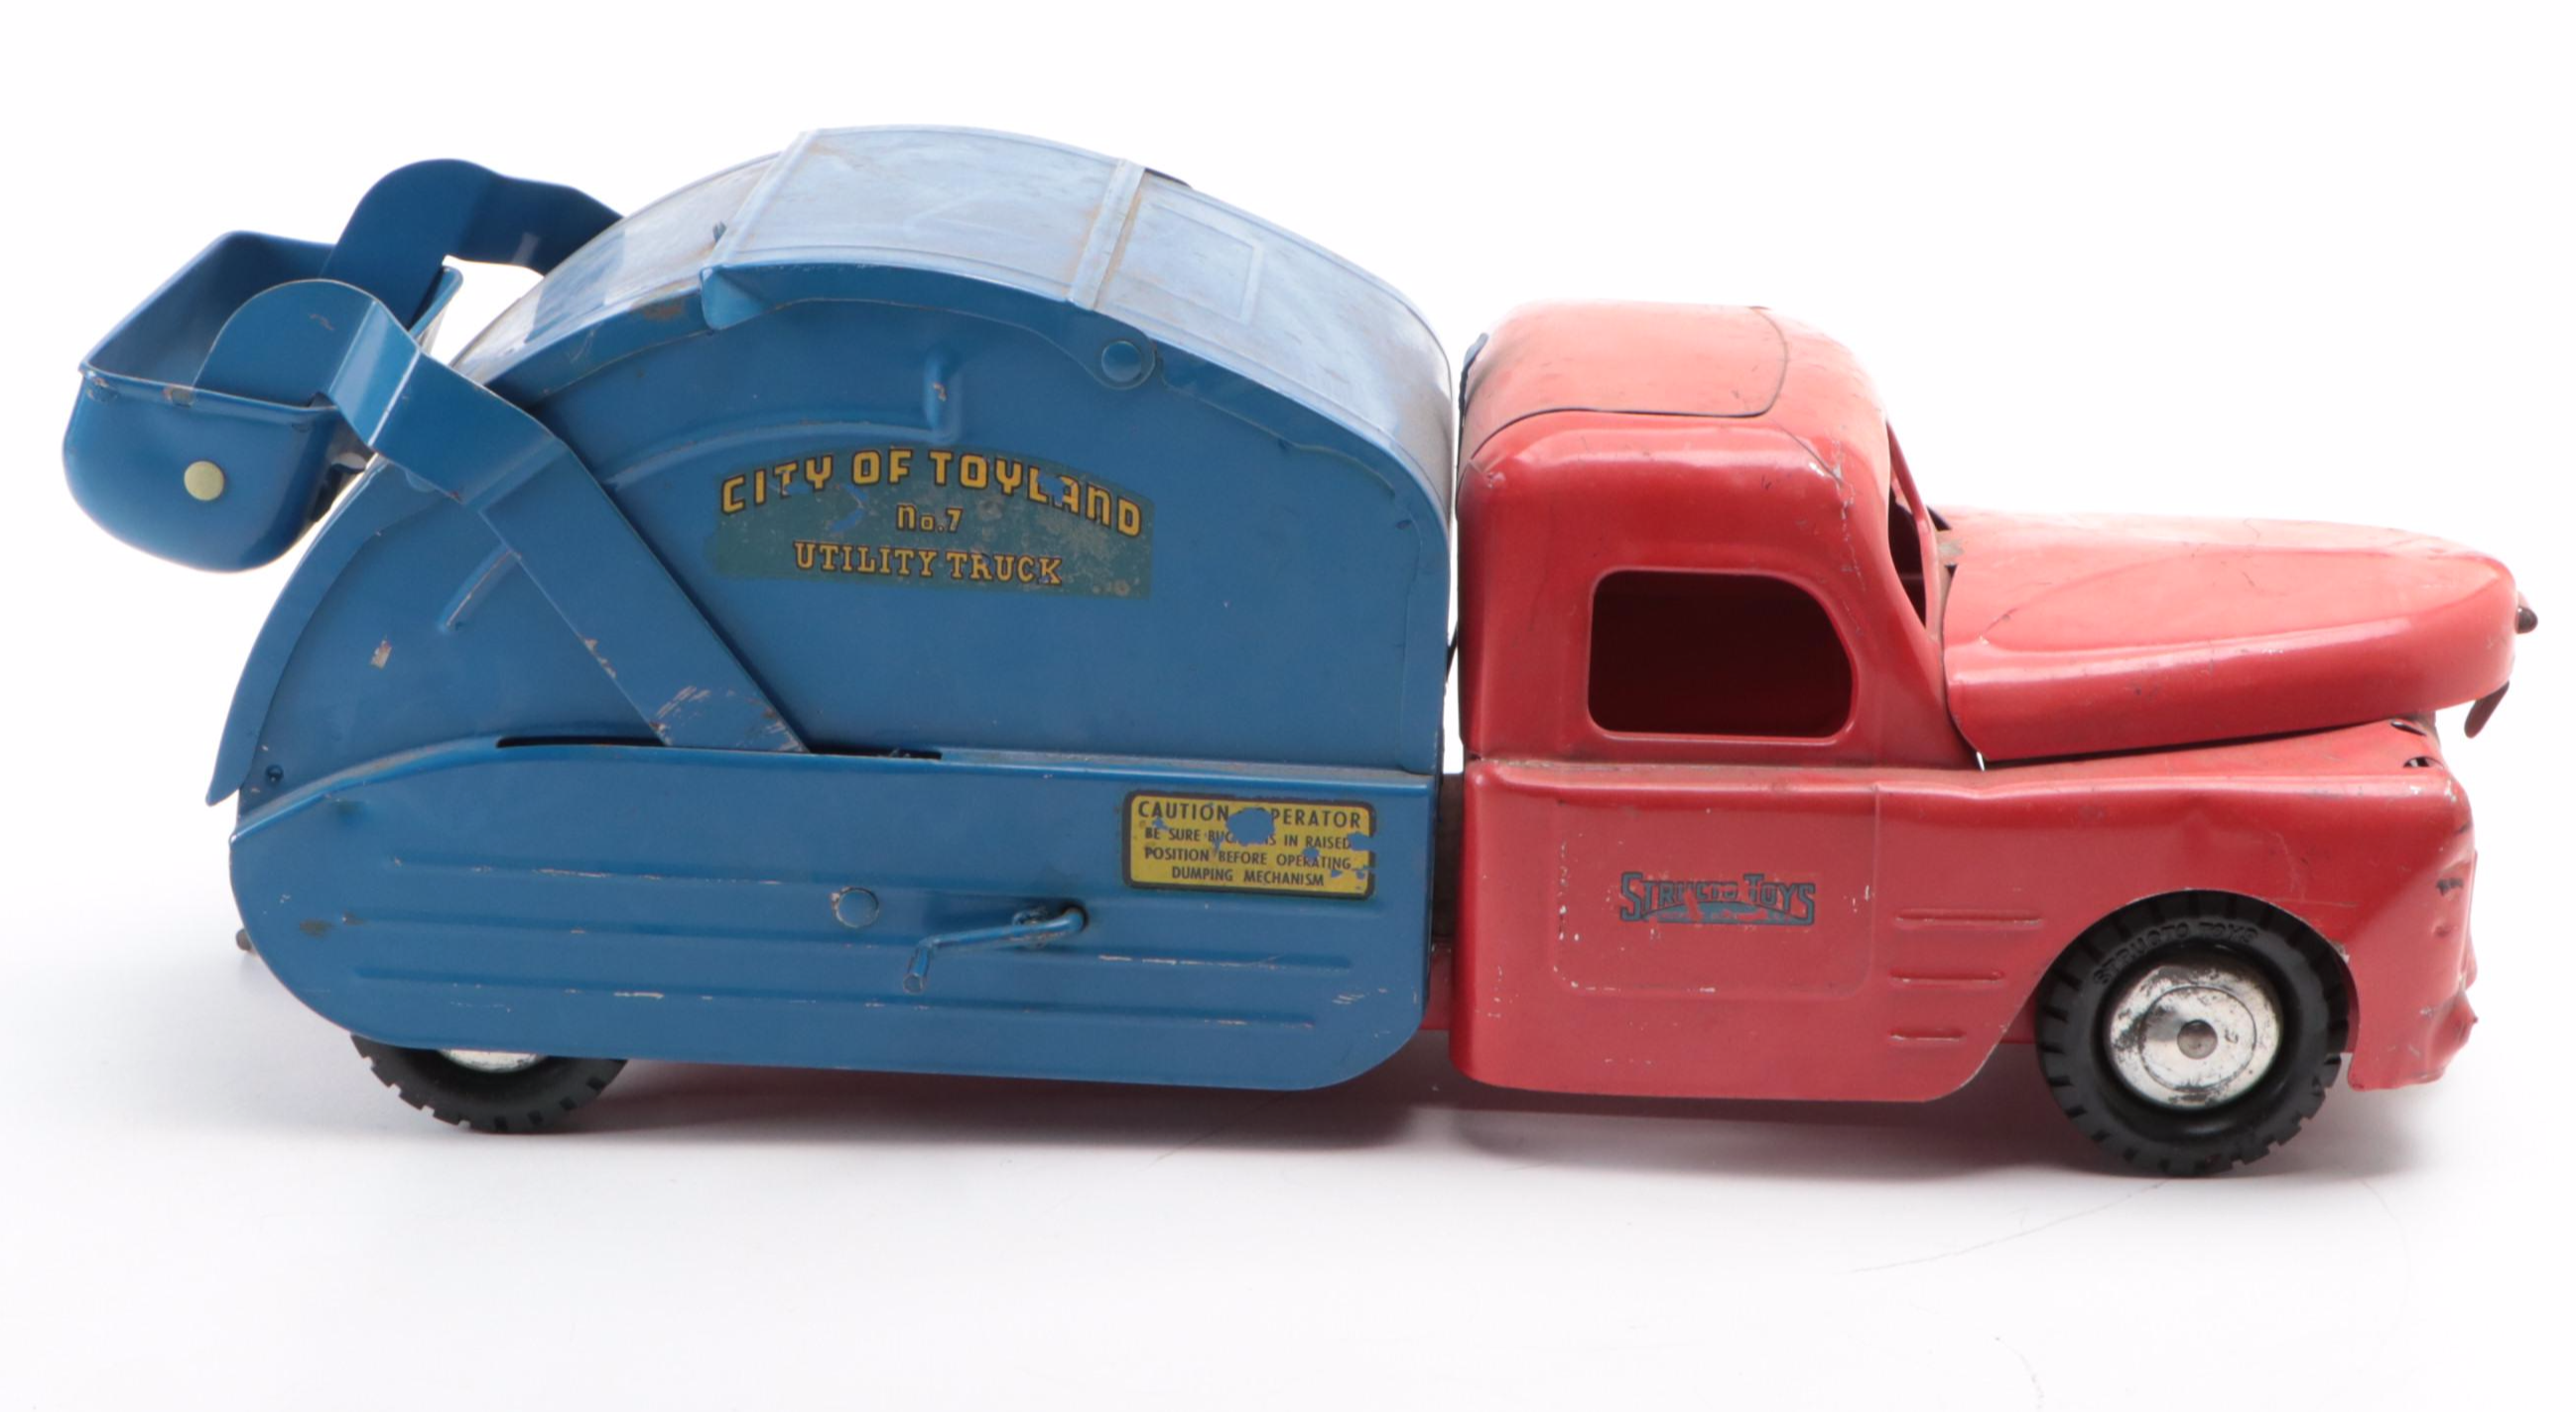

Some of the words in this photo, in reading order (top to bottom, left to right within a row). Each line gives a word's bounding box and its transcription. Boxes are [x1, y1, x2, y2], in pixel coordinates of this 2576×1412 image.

[721, 452, 834, 514] CITY
[850, 449, 913, 485] OF
[929, 449, 1143, 538] TOYLAND
[794, 539, 938, 576] UTILITY
[945, 549, 1064, 586] TRUCK
[1138, 800, 1229, 823] CAUTION
[1249, 806, 1360, 830] PERATOR
[1145, 827, 1160, 839] BE
[1169, 829, 1201, 841] SURE
[1284, 836, 1299, 848] IN
[1306, 837, 1351, 851] RAISED
[1145, 846, 1210, 862] POSITION
[1219, 850, 1267, 865] BEFORE
[1172, 866, 1233, 882] DUMPING
[1243, 869, 1324, 887] MECHANISM
[1742, 872, 1815, 926] TOYS
[2093, 922, 2190, 985] STRUCTO
[2198, 922, 2259, 944] TOYS
